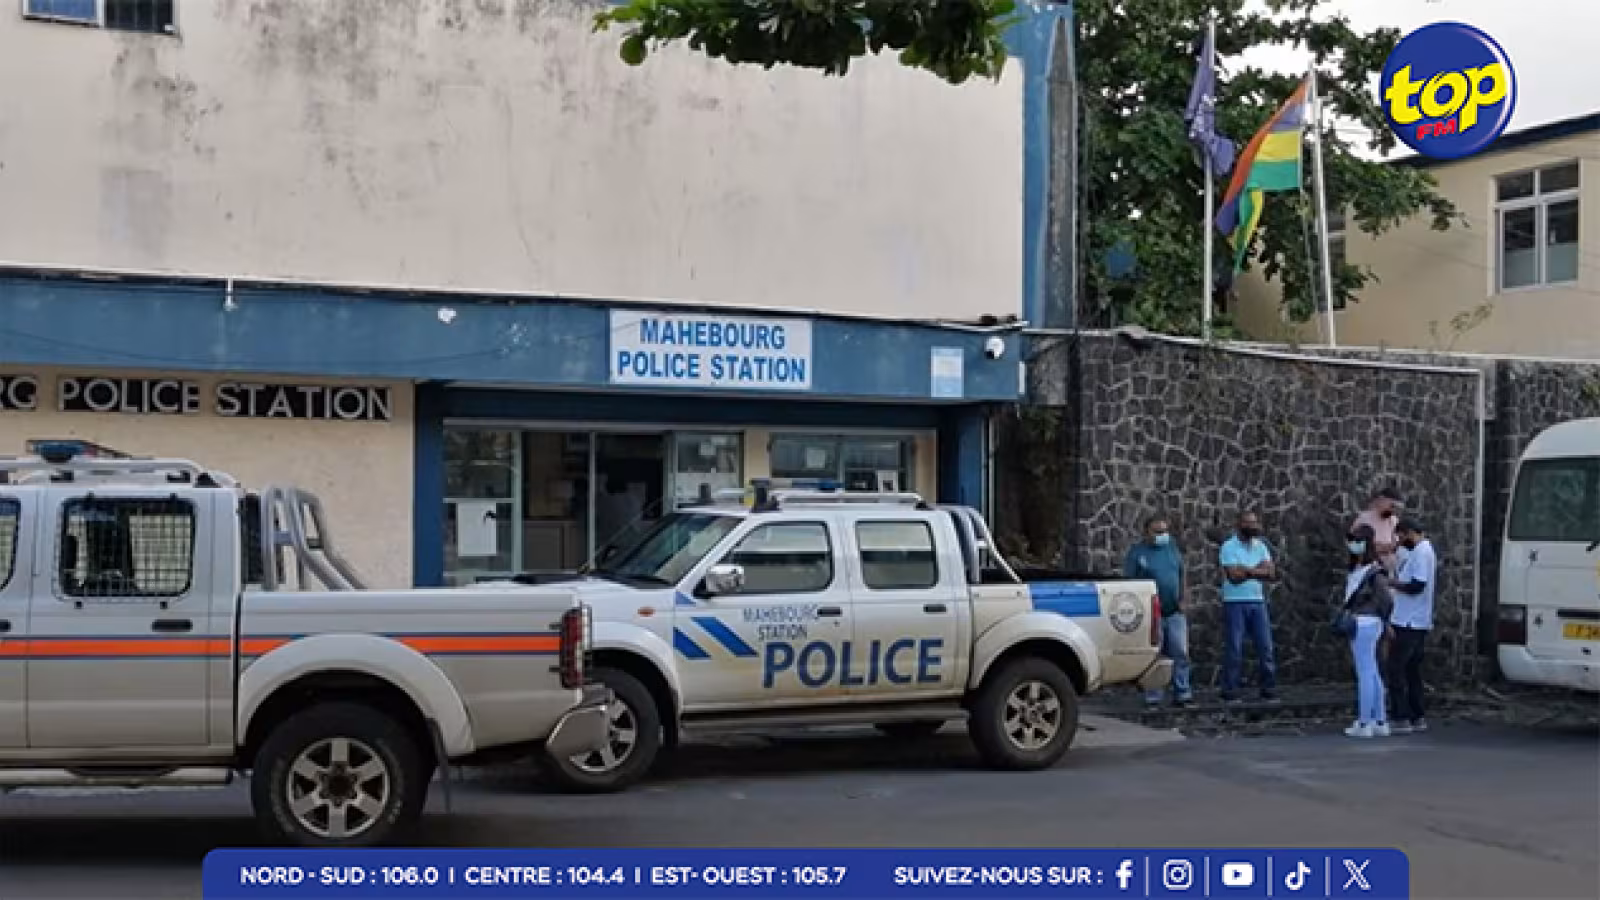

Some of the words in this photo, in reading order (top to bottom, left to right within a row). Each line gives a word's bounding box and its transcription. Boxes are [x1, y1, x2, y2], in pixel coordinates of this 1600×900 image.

[640, 318, 786, 350] MAHEBOURG
[617, 350, 701, 379] POLICE
[709, 353, 807, 383] STATION
[0, 376, 38, 409] G
[59, 377, 201, 413] POLICE
[216, 382, 393, 421] STATION
[758, 624, 808, 641] STATION
[763, 637, 944, 689] POLICE
